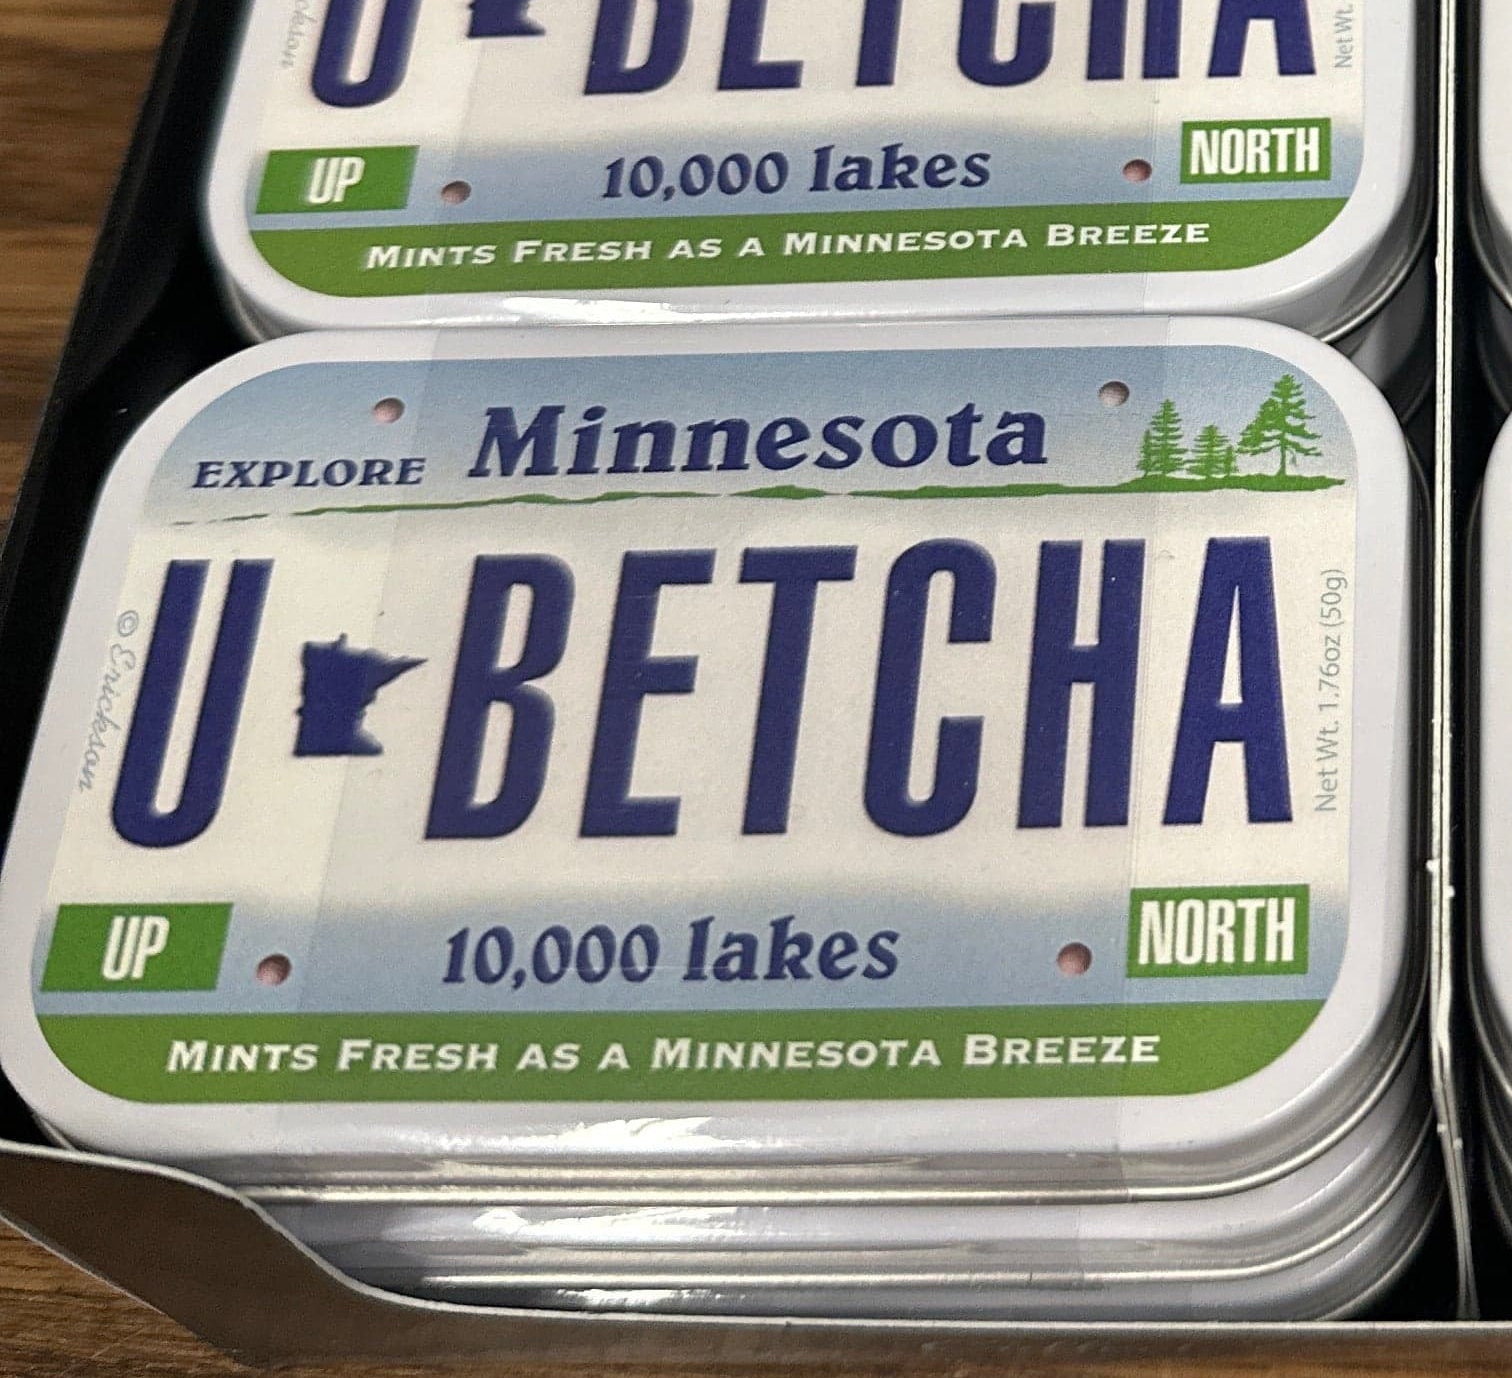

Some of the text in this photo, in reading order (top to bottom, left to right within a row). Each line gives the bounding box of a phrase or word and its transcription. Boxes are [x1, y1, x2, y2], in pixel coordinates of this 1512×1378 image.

[1334, 5, 1353, 34] Wt.
[1334, 38, 1354, 68] Net
[307, 157, 364, 204] UP
[602, 143, 991, 202] 10,000 lakes
[1190, 127, 1319, 175] NORTH
[191, 403, 1048, 490] EXPLORE Minnesota
[111, 536, 1294, 849] U BETCHA
[1316, 568, 1346, 813] Net Wt. 1.76oz (50g)
[102, 916, 170, 981] UP
[442, 916, 901, 990] 10,000 lakes
[1138, 897, 1295, 964] NORTH
